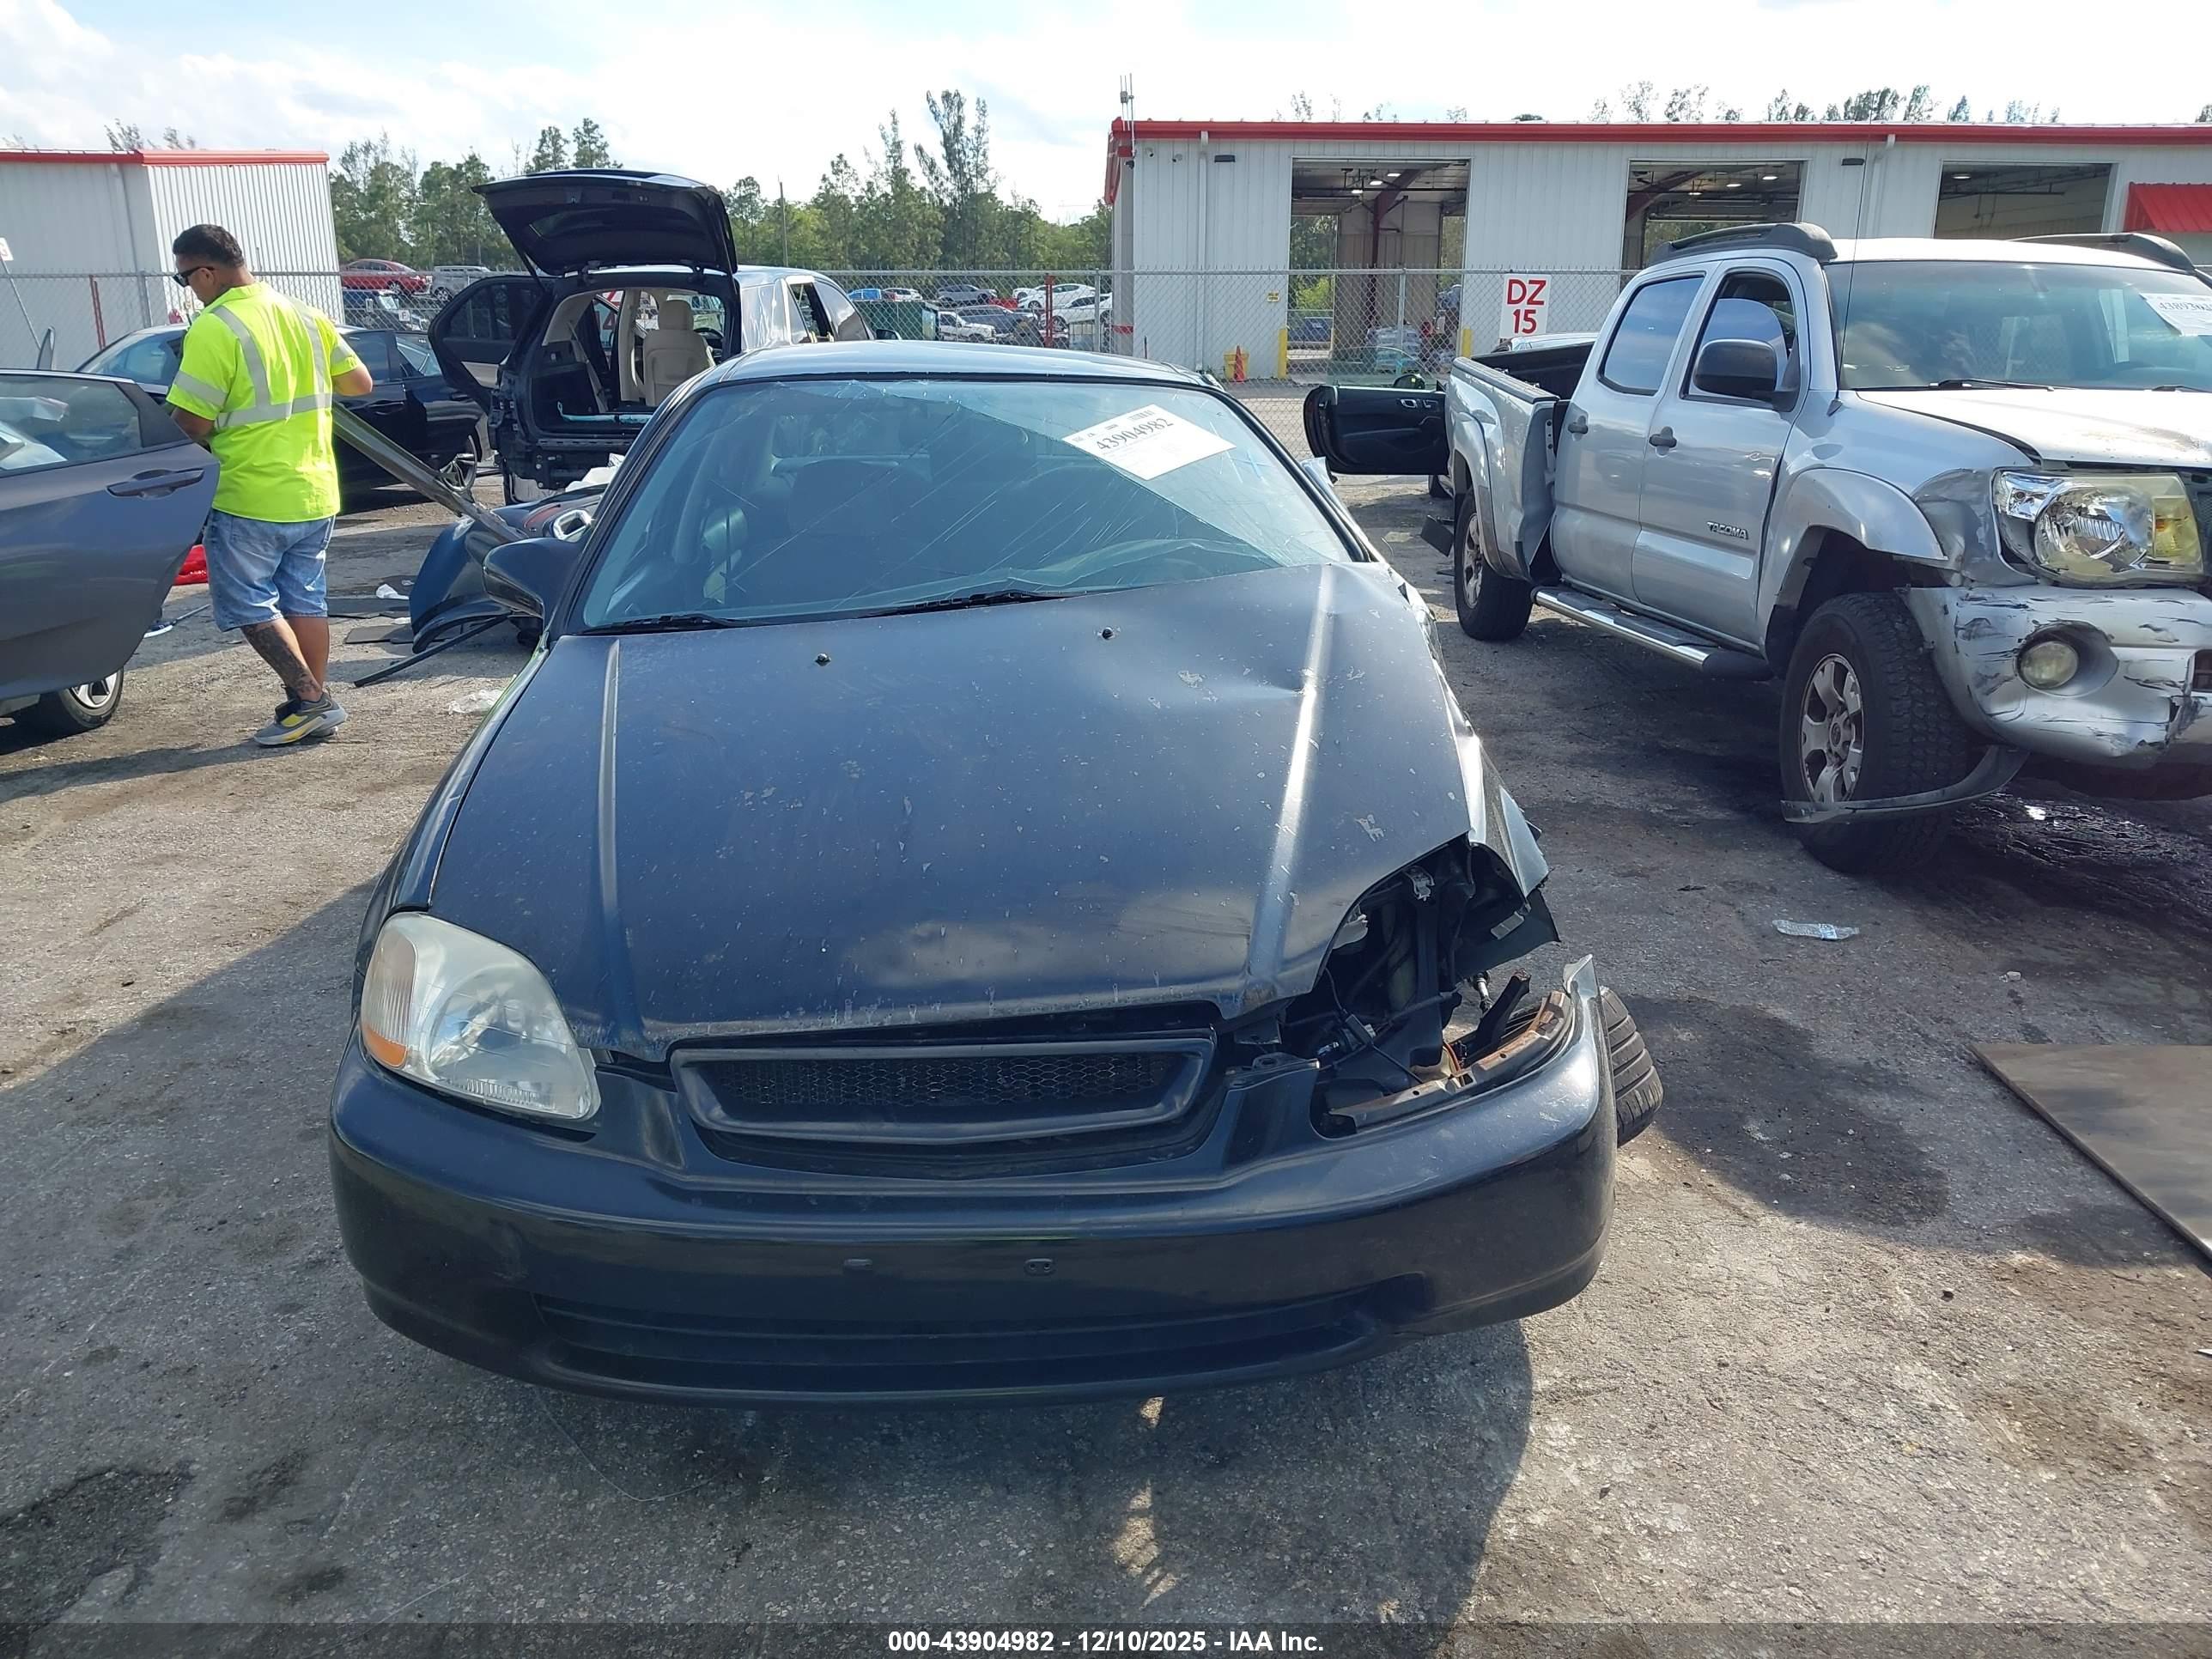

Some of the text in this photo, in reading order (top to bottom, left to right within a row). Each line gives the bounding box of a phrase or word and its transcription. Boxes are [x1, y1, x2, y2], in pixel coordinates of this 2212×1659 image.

[1507, 279, 1547, 305] DZ
[1513, 309, 1536, 334] 15
[1097, 418, 1174, 450] 43904982
[1706, 521, 1749, 540] TACOMA
